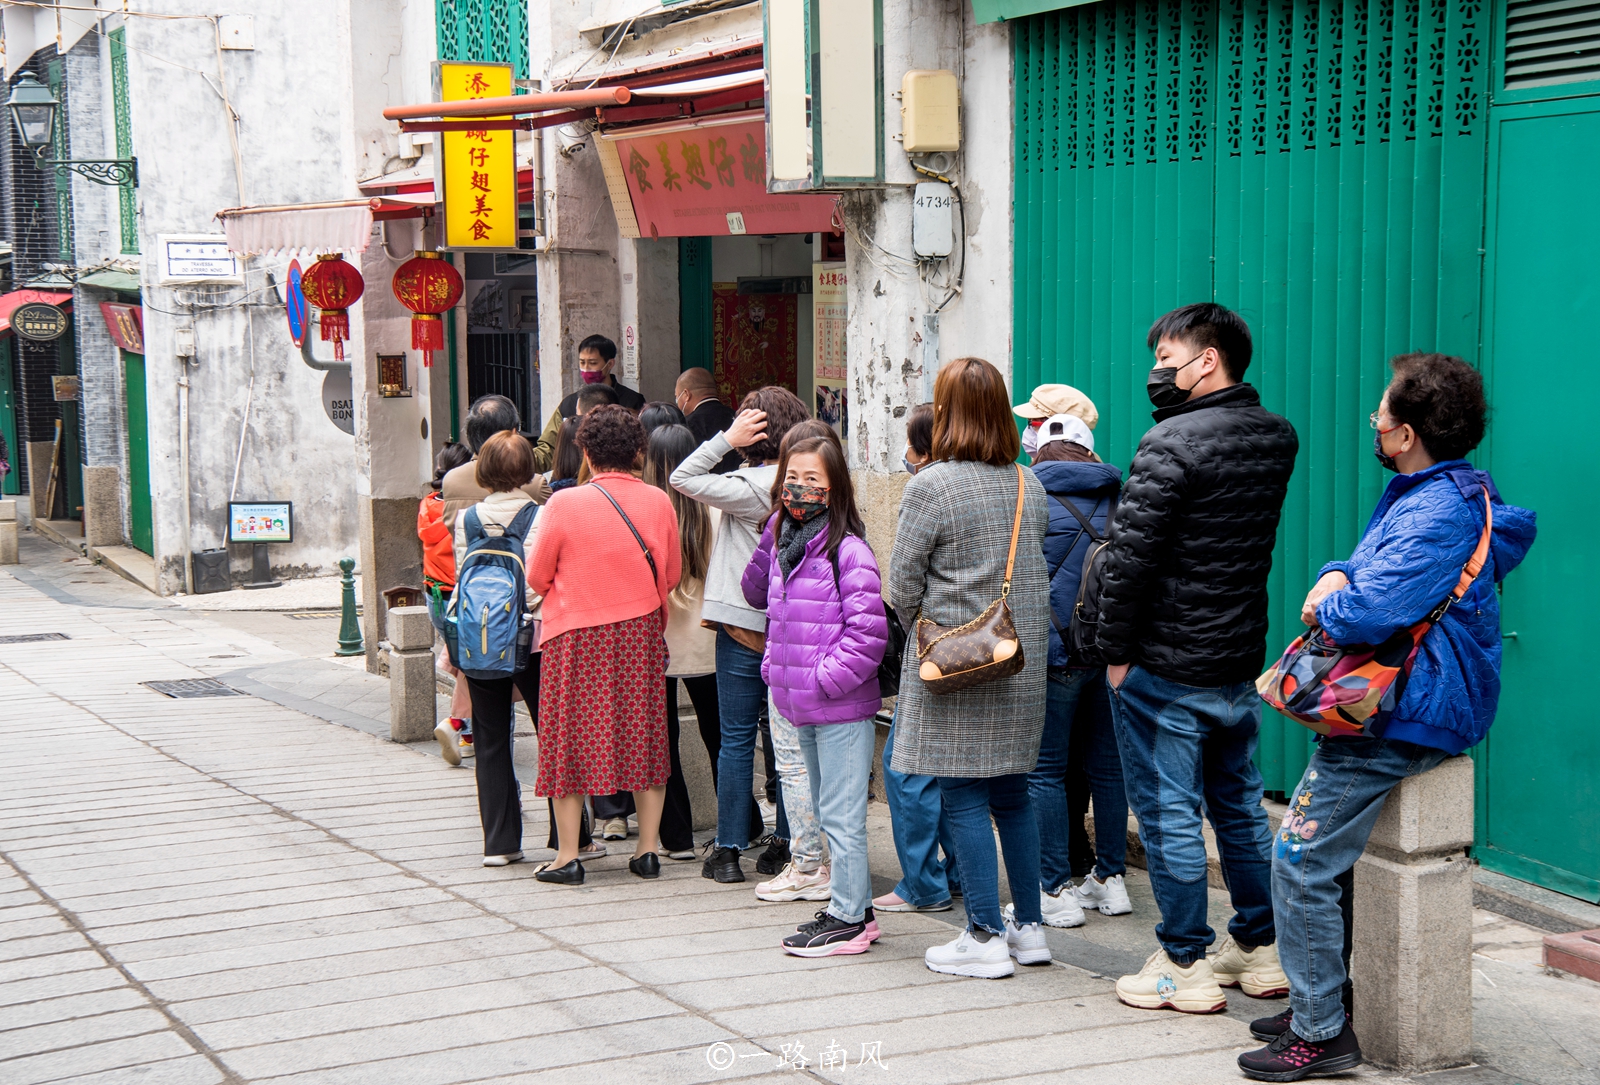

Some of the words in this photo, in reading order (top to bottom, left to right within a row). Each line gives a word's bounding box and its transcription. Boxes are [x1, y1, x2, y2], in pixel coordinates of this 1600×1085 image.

[465, 72, 493, 241] 添碗仔翅美食
[916, 196, 950, 208] 4734
